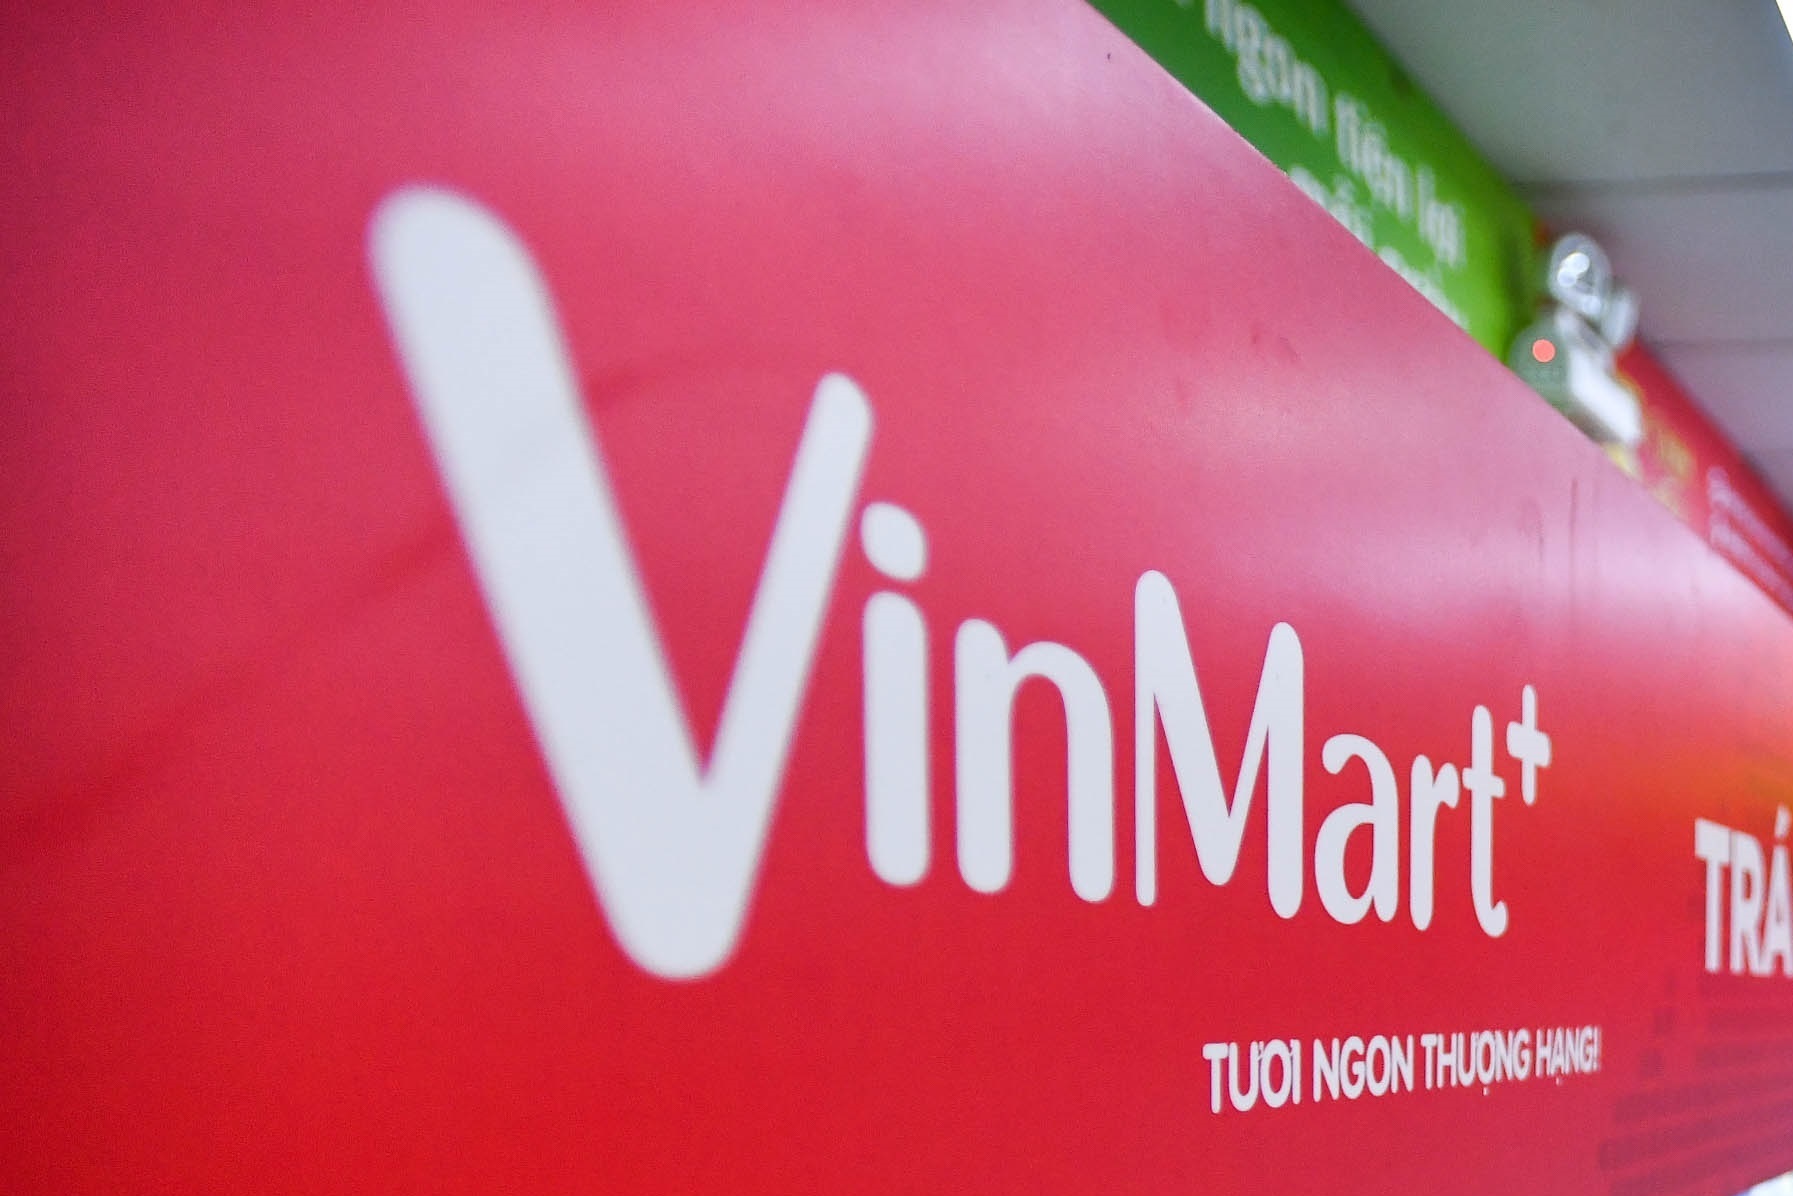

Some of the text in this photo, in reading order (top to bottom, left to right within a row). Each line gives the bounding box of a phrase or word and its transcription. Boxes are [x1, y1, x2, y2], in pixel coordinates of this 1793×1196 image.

[1203, 1025, 1600, 1114] TƯƠI NGON THƯỢNG HẠNG!
